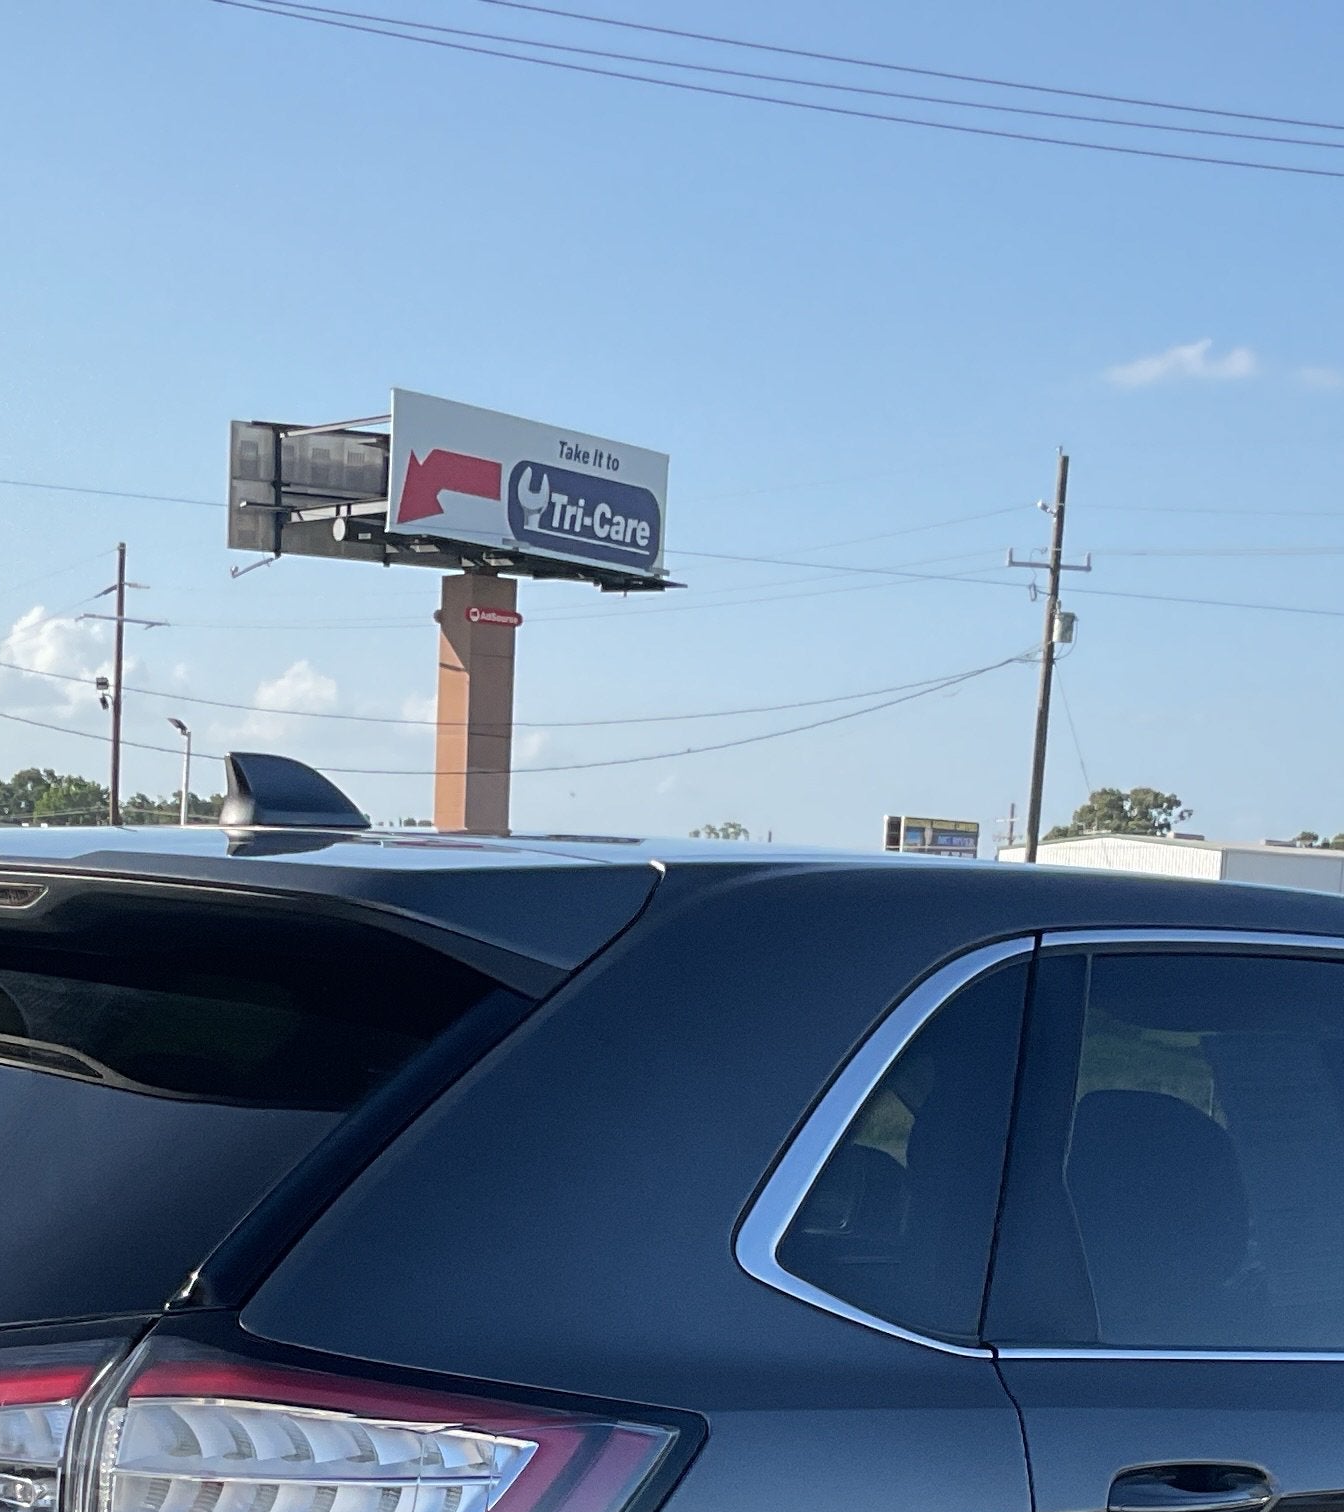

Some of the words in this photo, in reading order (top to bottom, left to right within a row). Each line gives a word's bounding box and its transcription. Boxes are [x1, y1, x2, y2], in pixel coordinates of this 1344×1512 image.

[559, 440, 590, 464] Take
[606, 453, 620, 472] to
[550, 491, 651, 547] Tri-Care
